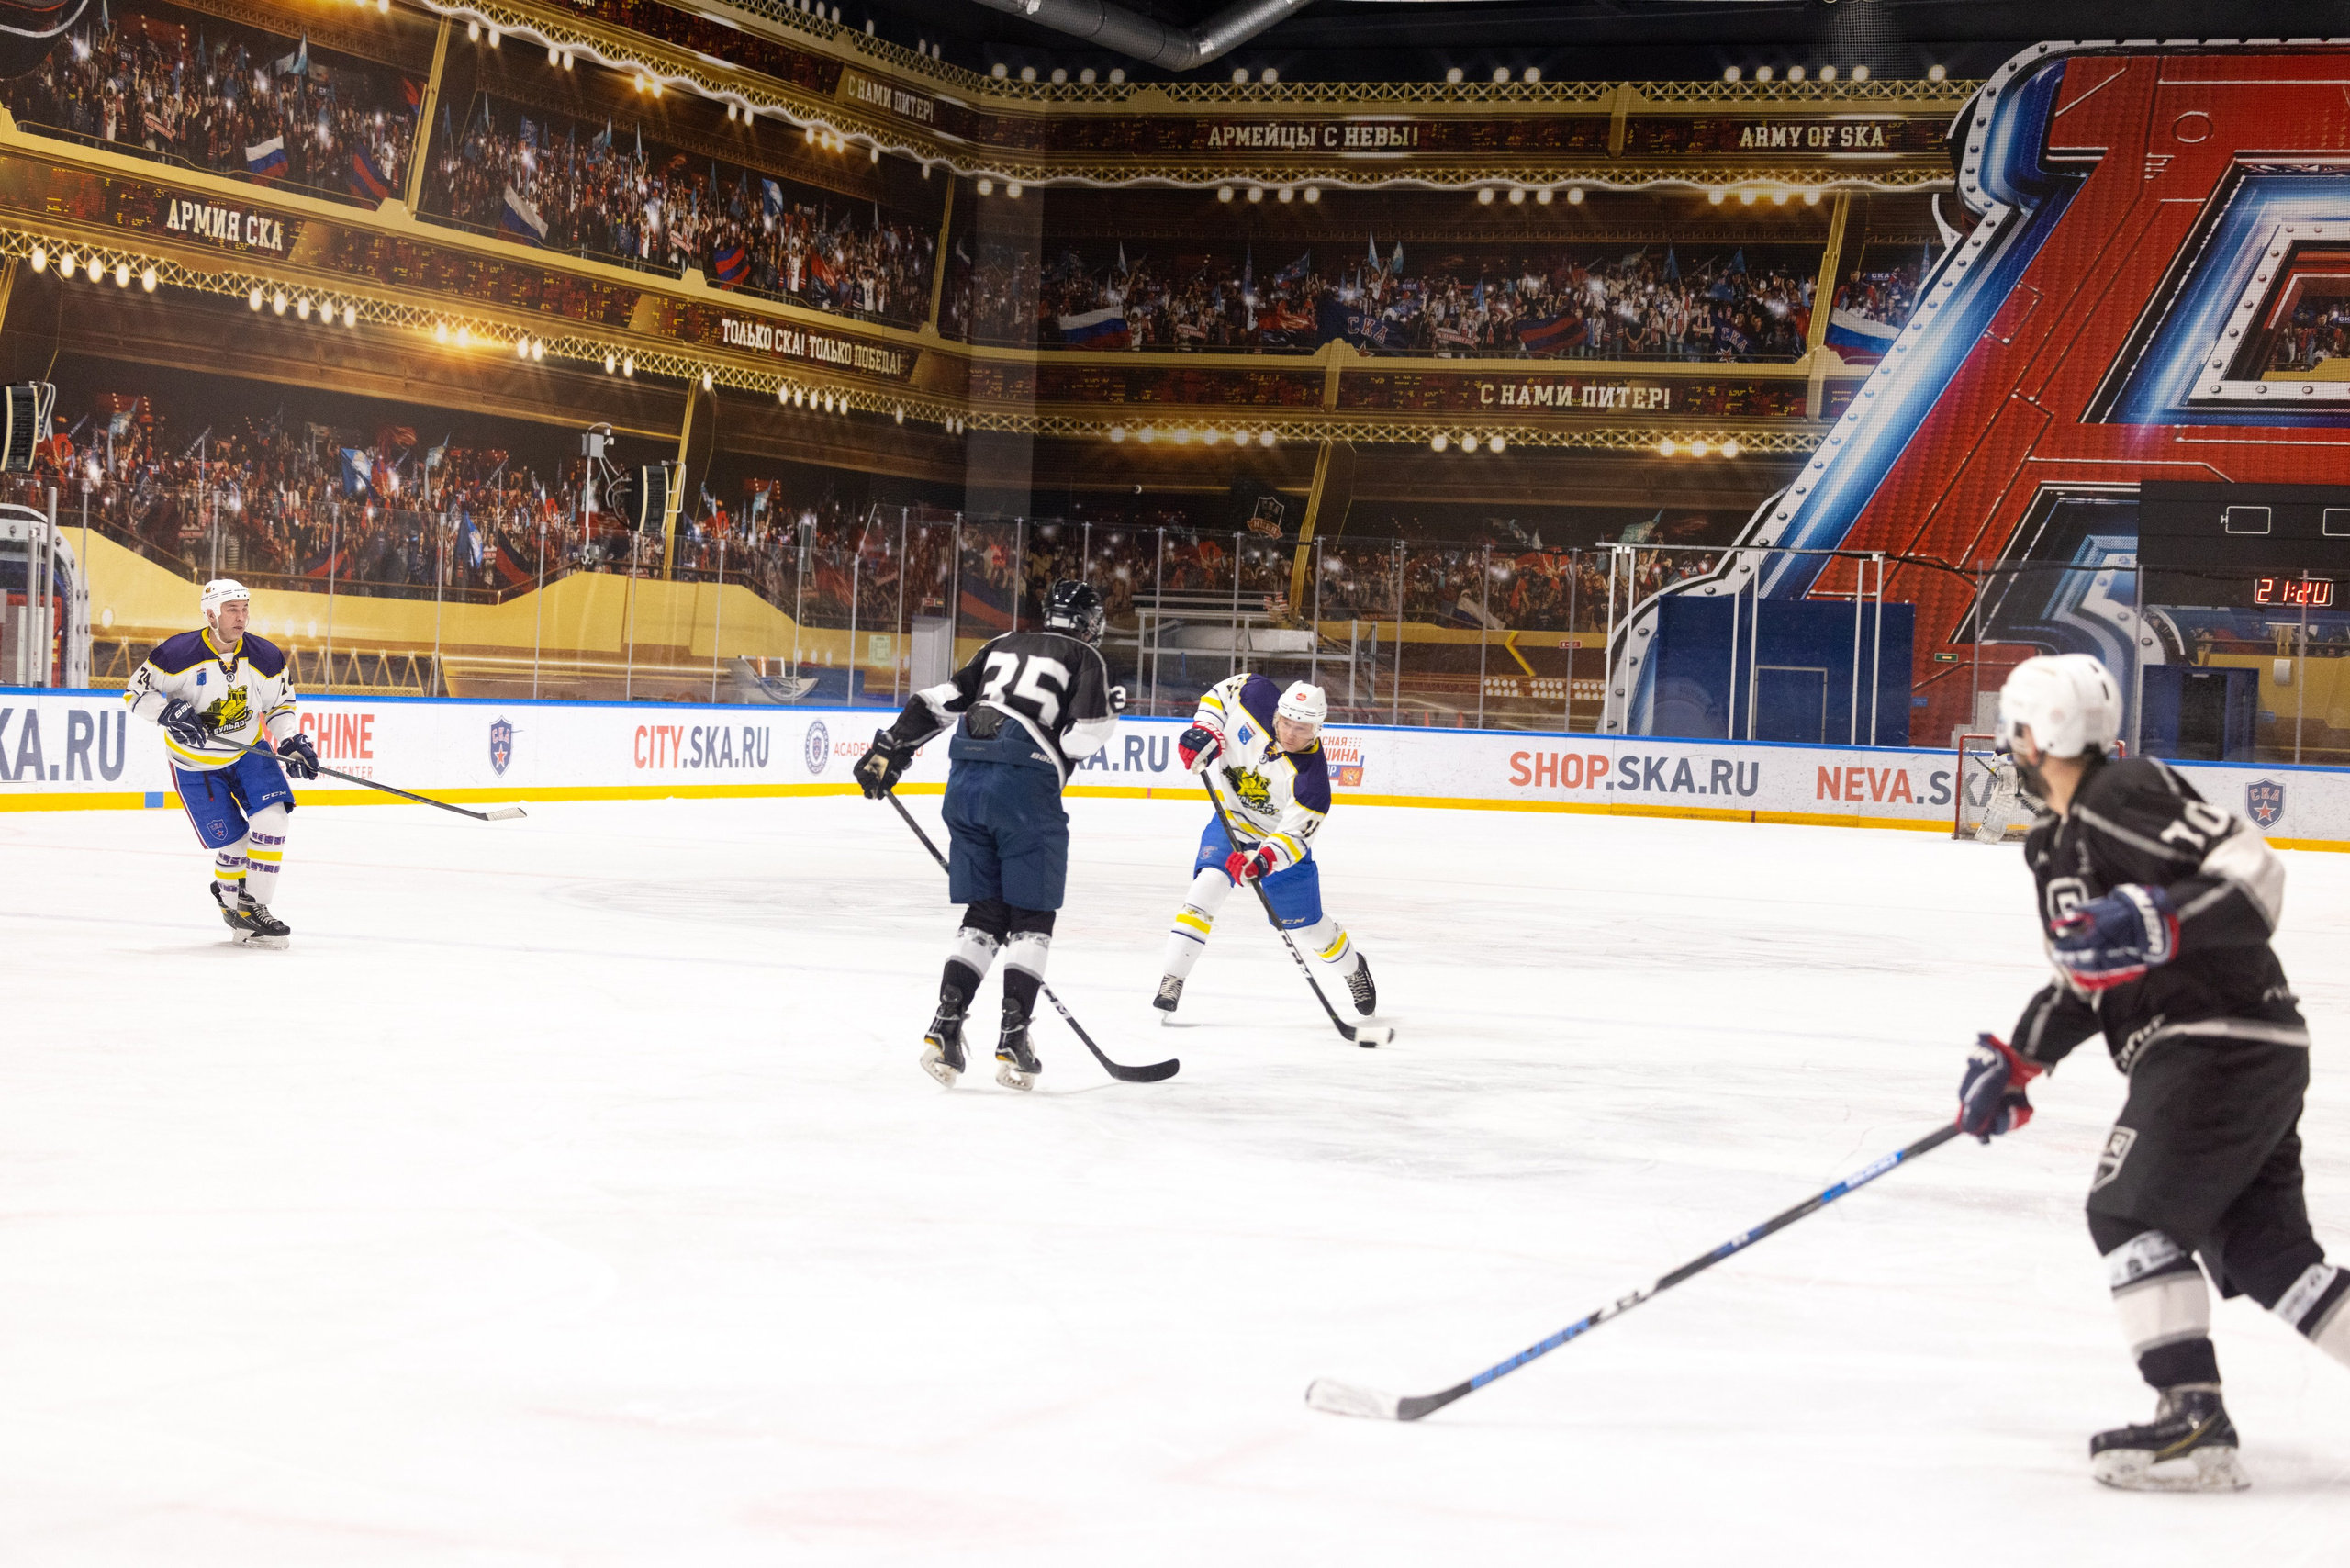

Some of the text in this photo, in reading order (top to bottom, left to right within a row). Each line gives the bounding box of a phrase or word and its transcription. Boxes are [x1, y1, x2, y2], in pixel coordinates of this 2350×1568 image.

[848, 75, 934, 124] С НАМИ ПИТЕР!
[1207, 122, 1418, 150] АРМЕЙЦЫ С НЕВЫ!
[1740, 126, 1885, 148] ARMY OF SKA
[166, 198, 283, 252] АРМИЯ СКА
[722, 318, 901, 375] ТОЛЬКО СКА! ТОЛЬКО ПОБЕДА!
[1480, 384, 1671, 409] С НАМИ ПИТЕР!
[979, 650, 1072, 731] 35
[634, 724, 770, 769] CITY.SKA.RU
[1076, 734, 1170, 773] A.RU
[1508, 750, 1761, 797] SHOP.SKA.RU
[262, 790, 287, 801] CCM
[2249, 787, 2281, 802] СКА
[1279, 917, 1306, 925] CM
